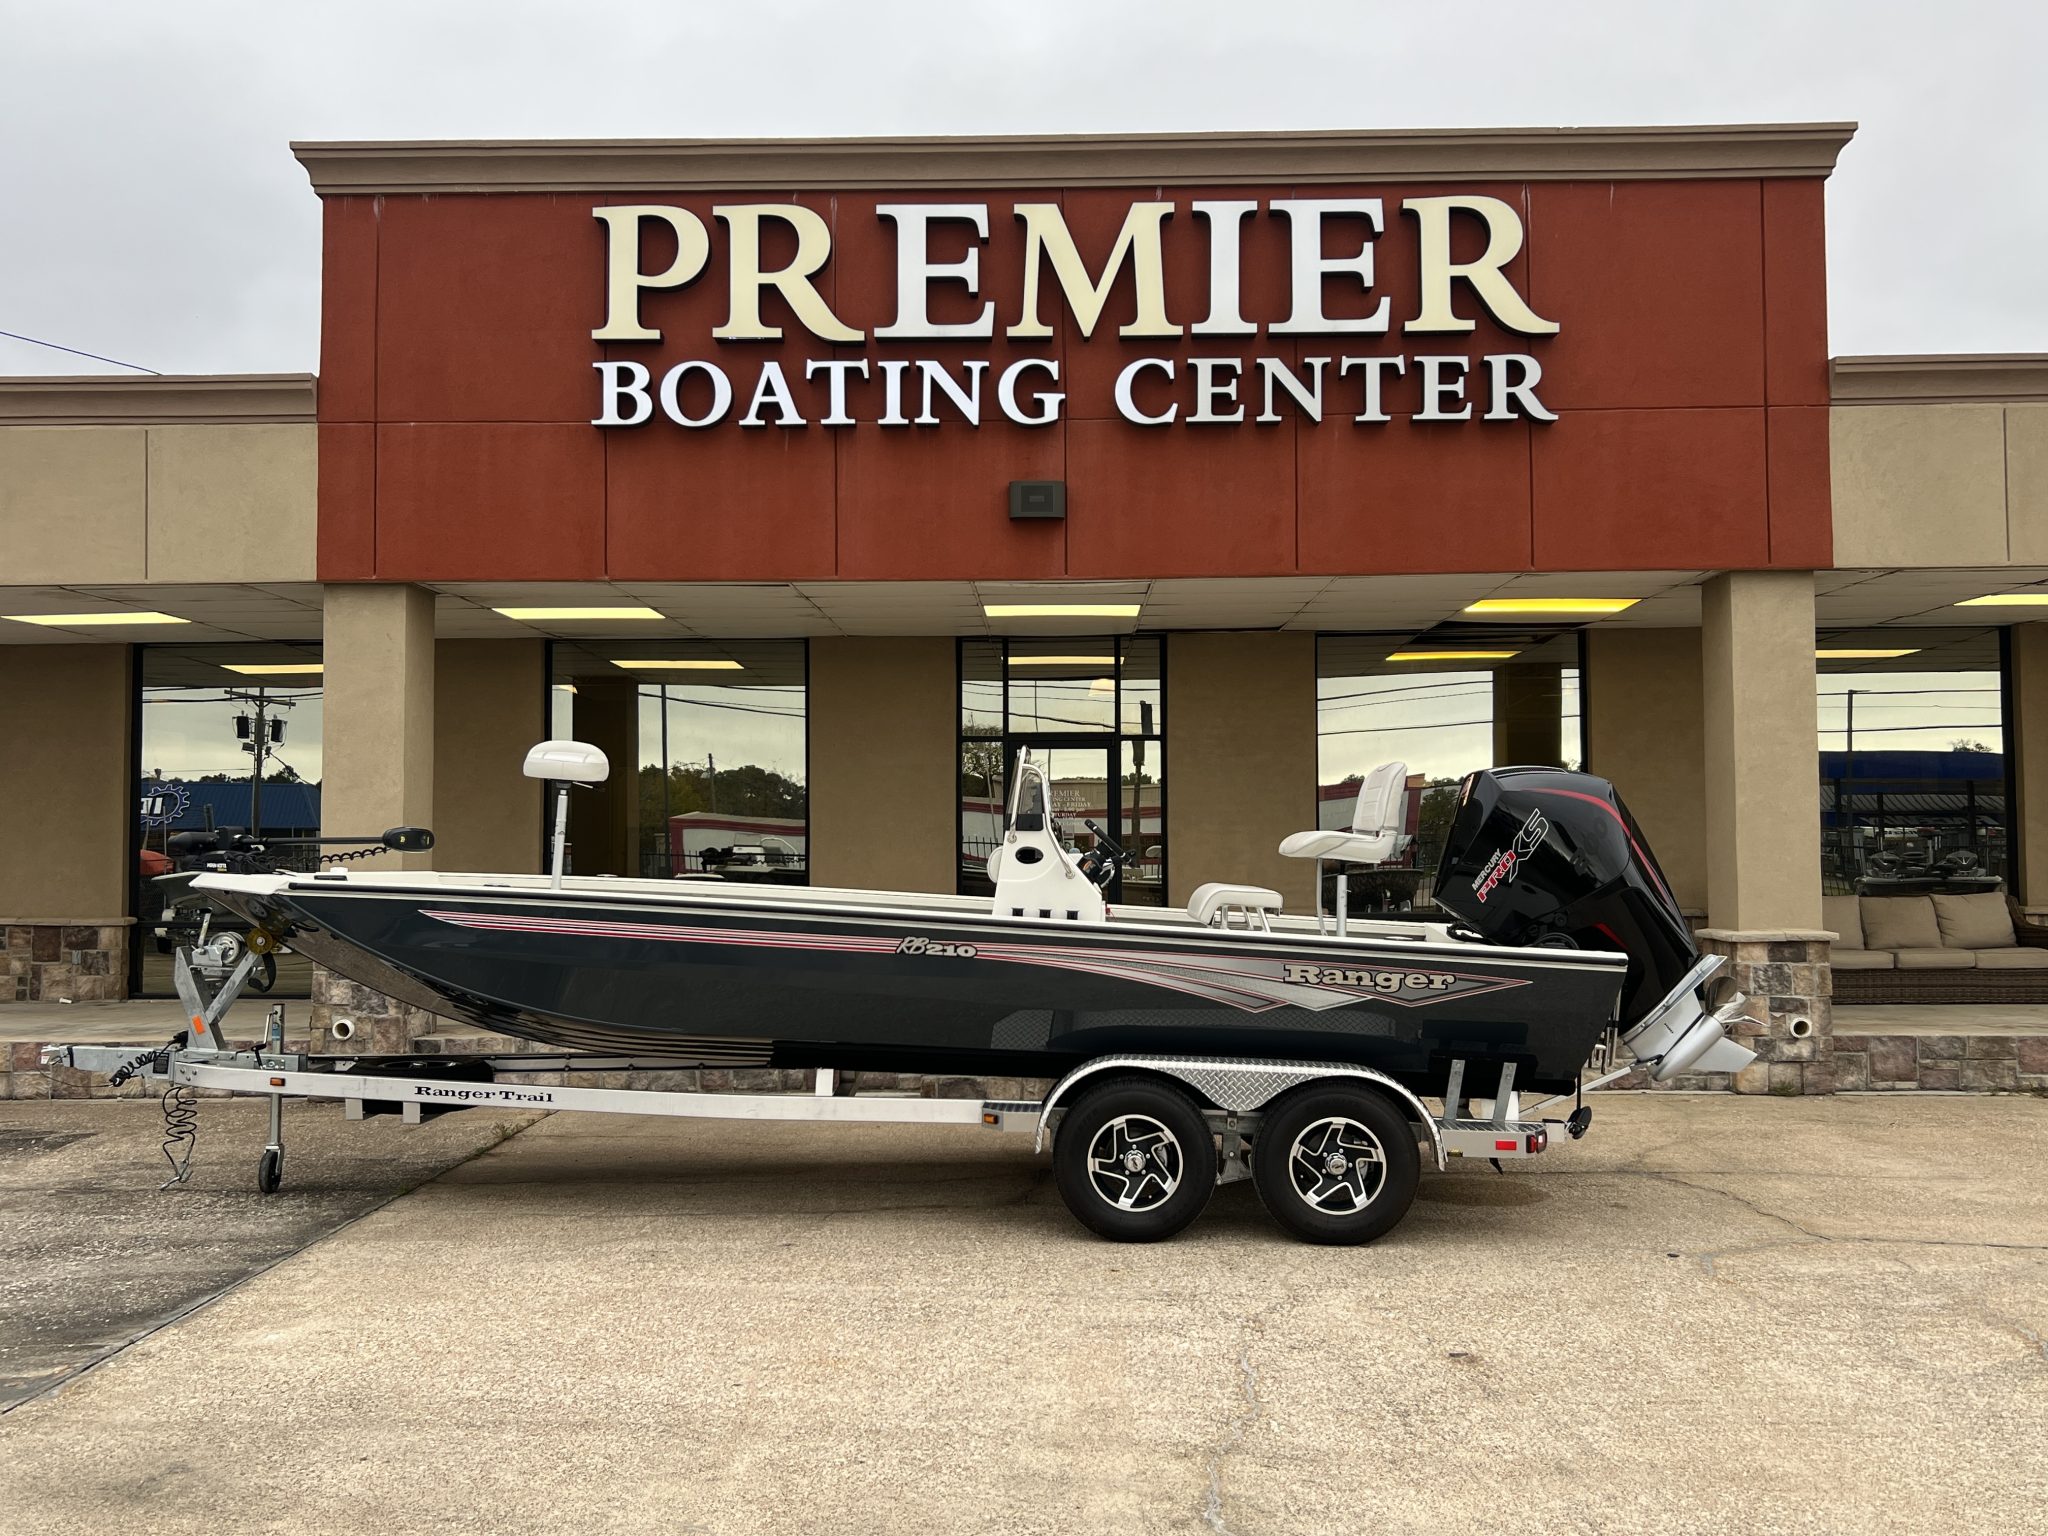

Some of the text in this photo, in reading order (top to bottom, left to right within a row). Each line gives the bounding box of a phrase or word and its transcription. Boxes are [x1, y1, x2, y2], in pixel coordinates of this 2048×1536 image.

[591, 196, 1560, 342] PREMIER
[591, 355, 1560, 427] BOATING CENTER
[1471, 848, 1501, 890] MERCURY
[1283, 964, 1457, 993] Ranger
[414, 1086, 554, 1102] Ranger Trail
